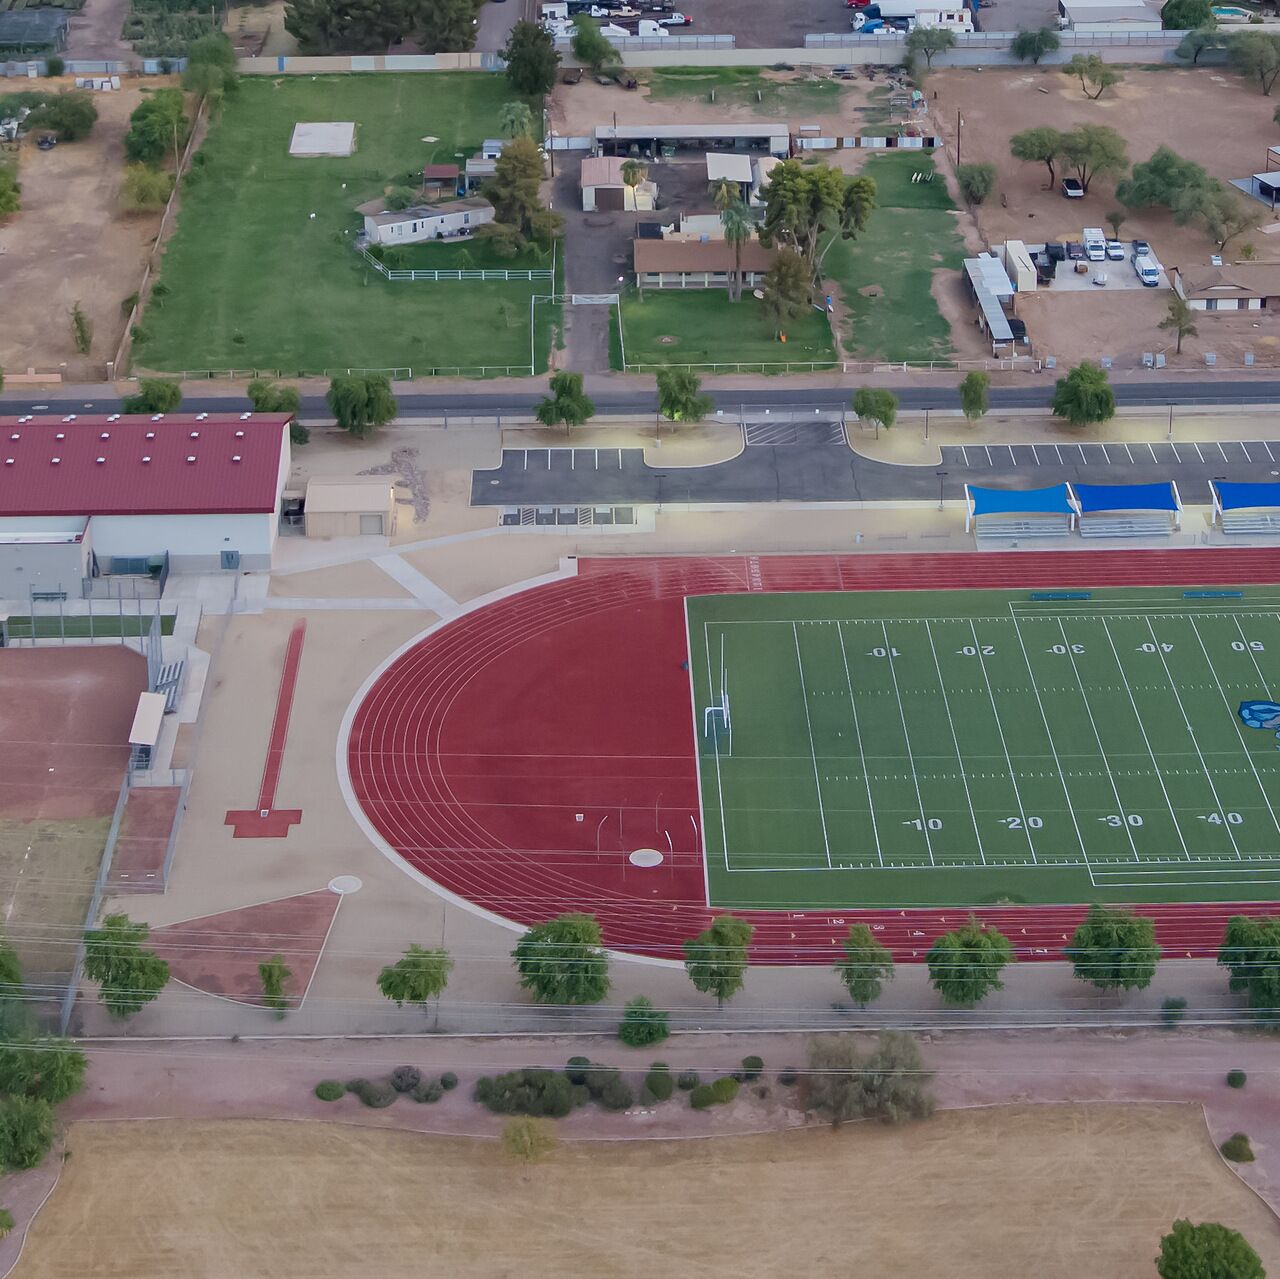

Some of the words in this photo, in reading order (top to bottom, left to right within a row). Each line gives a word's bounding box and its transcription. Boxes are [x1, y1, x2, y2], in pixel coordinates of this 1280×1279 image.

[872, 647, 901, 657] 10
[962, 645, 995, 656] 20
[1052, 644, 1086, 655] 30
[1142, 642, 1174, 653] 40
[1231, 640, 1265, 651] 50
[910, 818, 943, 831] 10
[1006, 816, 1044, 830] 20
[1105, 814, 1144, 827] 30
[1207, 812, 1244, 825] 40
